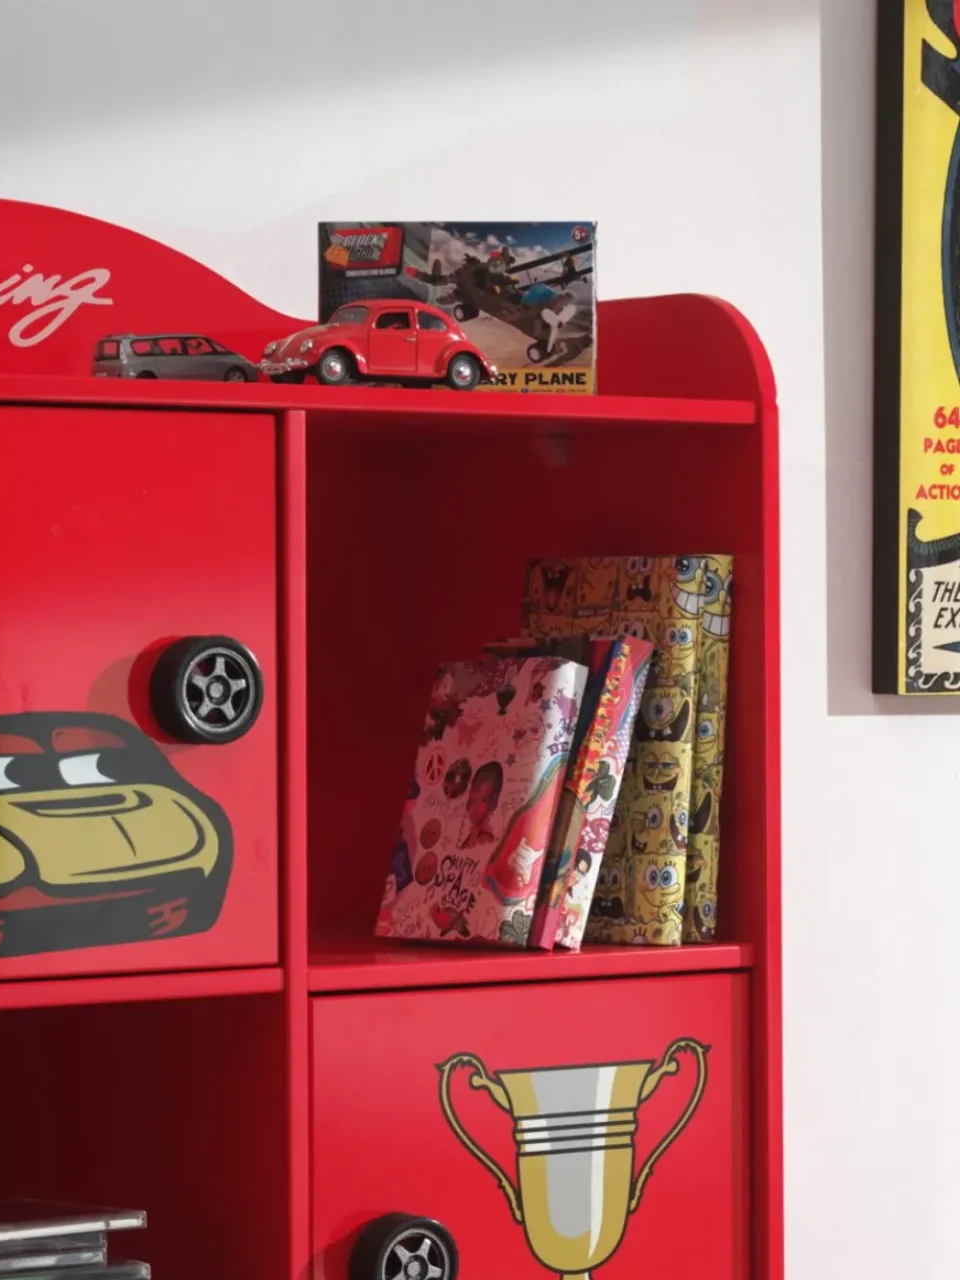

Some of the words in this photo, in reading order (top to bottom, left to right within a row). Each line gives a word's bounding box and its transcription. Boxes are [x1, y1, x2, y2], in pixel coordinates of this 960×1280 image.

[574, 230, 587, 240] 5+
[525, 372, 586, 385] PLANE
[934, 406, 960, 429] 64
[939, 463, 955, 476] OF
[933, 606, 960, 629] EX
